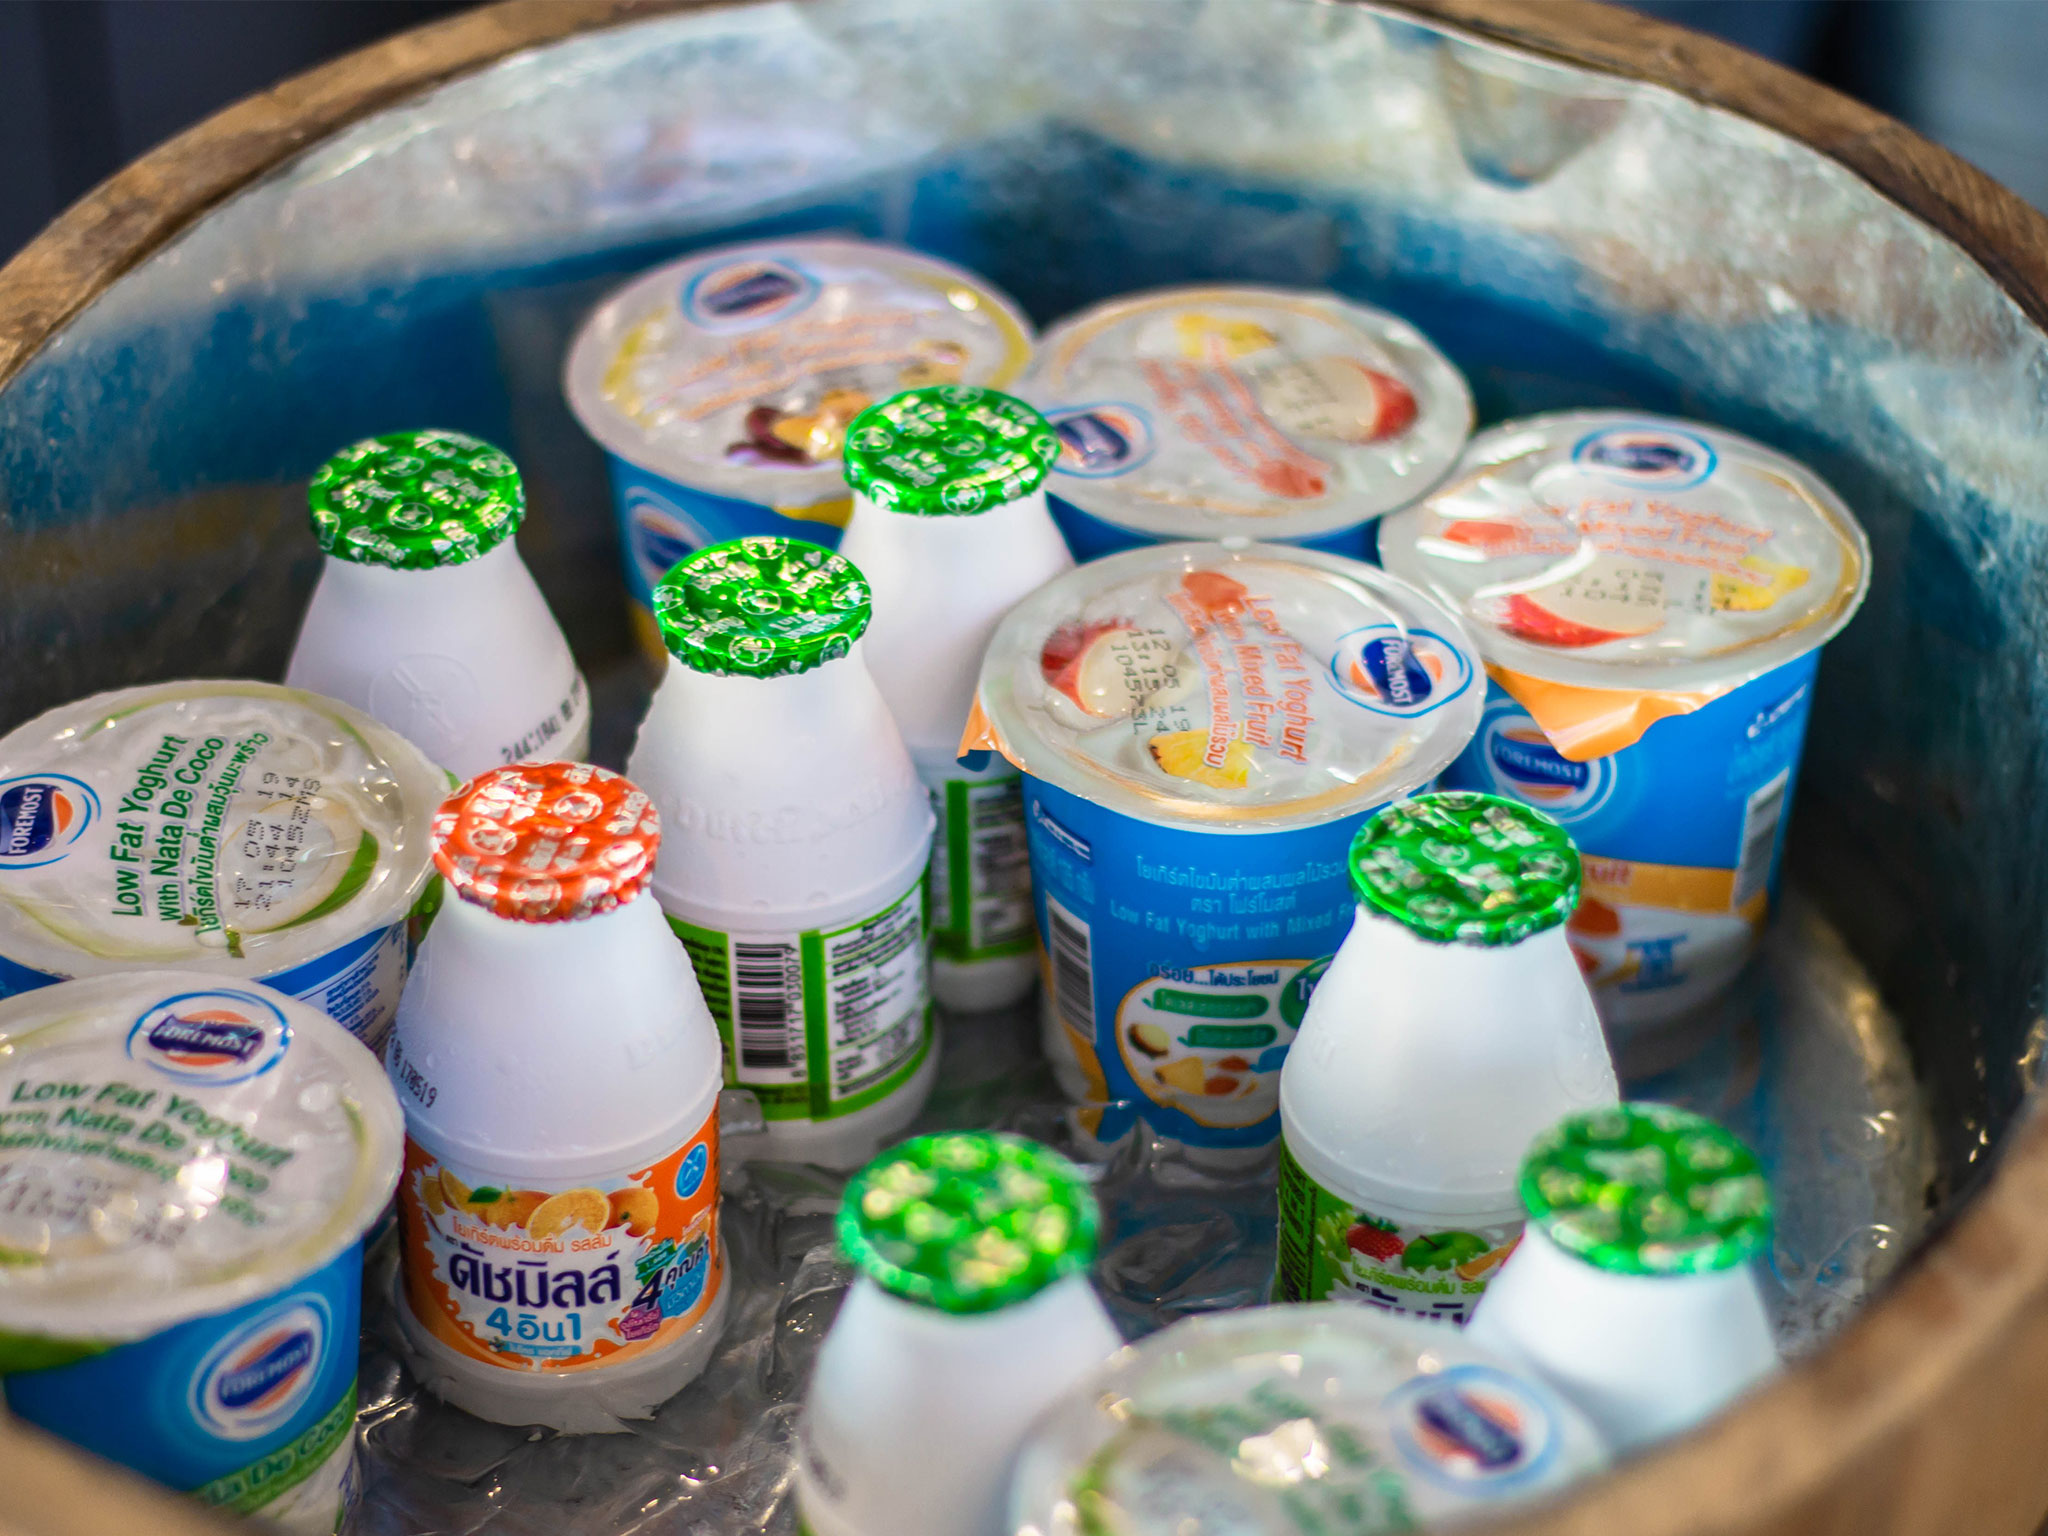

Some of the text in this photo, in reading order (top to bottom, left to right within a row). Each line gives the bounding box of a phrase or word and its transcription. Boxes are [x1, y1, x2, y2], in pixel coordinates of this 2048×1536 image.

[1148, 629, 1171, 651] 12
[1162, 664, 1181, 689] 05
[1233, 643, 1273, 698] Mixed
[1271, 642, 1307, 672] Fat
[1380, 638, 1413, 705] FOREMOST
[1246, 701, 1276, 747] Fruit
[1276, 677, 1314, 765] Yoghurt
[174, 737, 225, 786] Coco
[165, 788, 194, 820] De
[278, 776, 301, 800] 14
[8, 787, 44, 855] FOREMOST
[110, 734, 190, 918] Low Fat Yoghurt
[234, 772, 280, 909] 17 05 19
[150, 825, 185, 877] Nata
[1110, 899, 1140, 925] Low
[1146, 911, 1171, 934] Fat
[1176, 917, 1241, 944] Yoghurt
[1245, 922, 1280, 940] with
[1286, 909, 1333, 936] Mixed
[11, 1080, 90, 1103] Low
[95, 1081, 157, 1110] Fat
[449, 1242, 622, 1309] ดัชมิลล์
[486, 1306, 582, 1342] 4อิน1
